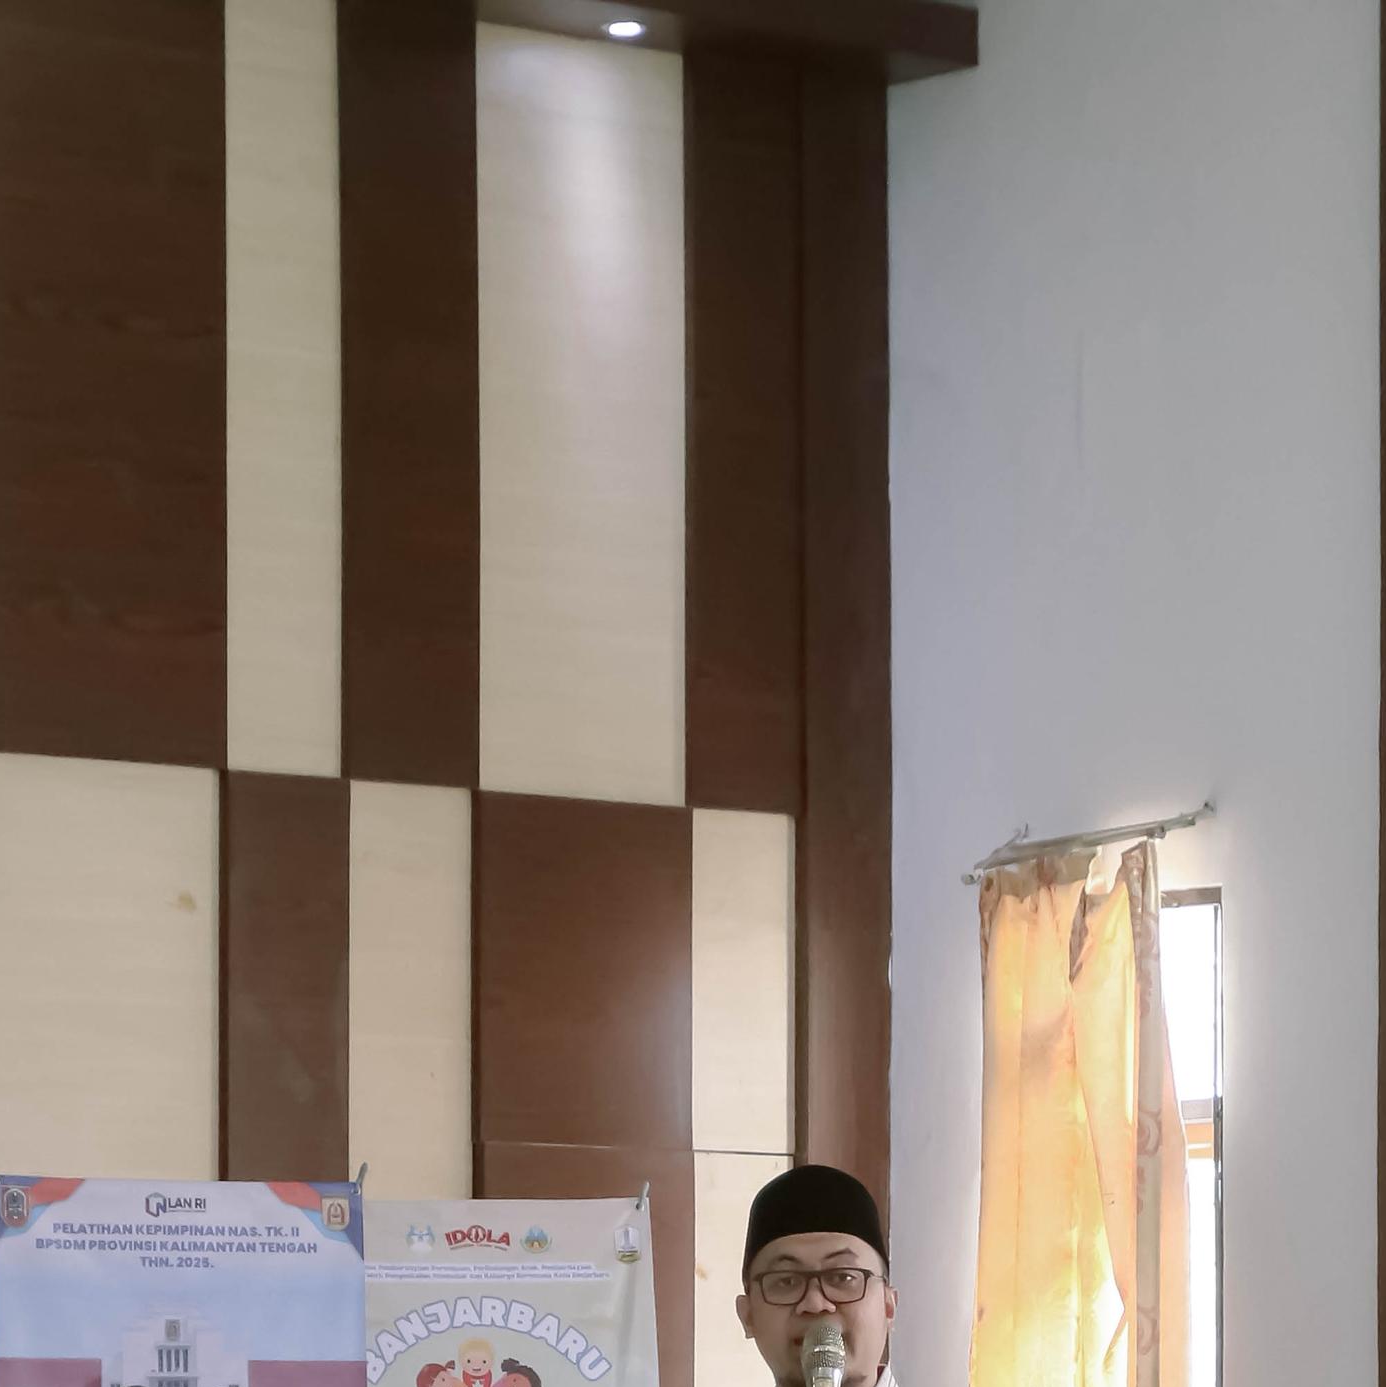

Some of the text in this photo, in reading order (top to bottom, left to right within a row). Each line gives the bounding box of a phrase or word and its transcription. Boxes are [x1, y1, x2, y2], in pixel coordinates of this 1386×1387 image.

[168, 1198, 206, 1209] LAN RI
[53, 1224, 132, 1234] PELATIHAN
[136, 1224, 225, 1236] KEPIMPINAN
[228, 1226, 262, 1237] NAS.
[265, 1227, 288, 1237] TK.
[36, 1239, 317, 1253] BPSDM PROVINSI KALIMANTAN TENGAH
[140, 1256, 174, 1267] THN.
[365, 1296, 612, 1384] BANJARBARU
